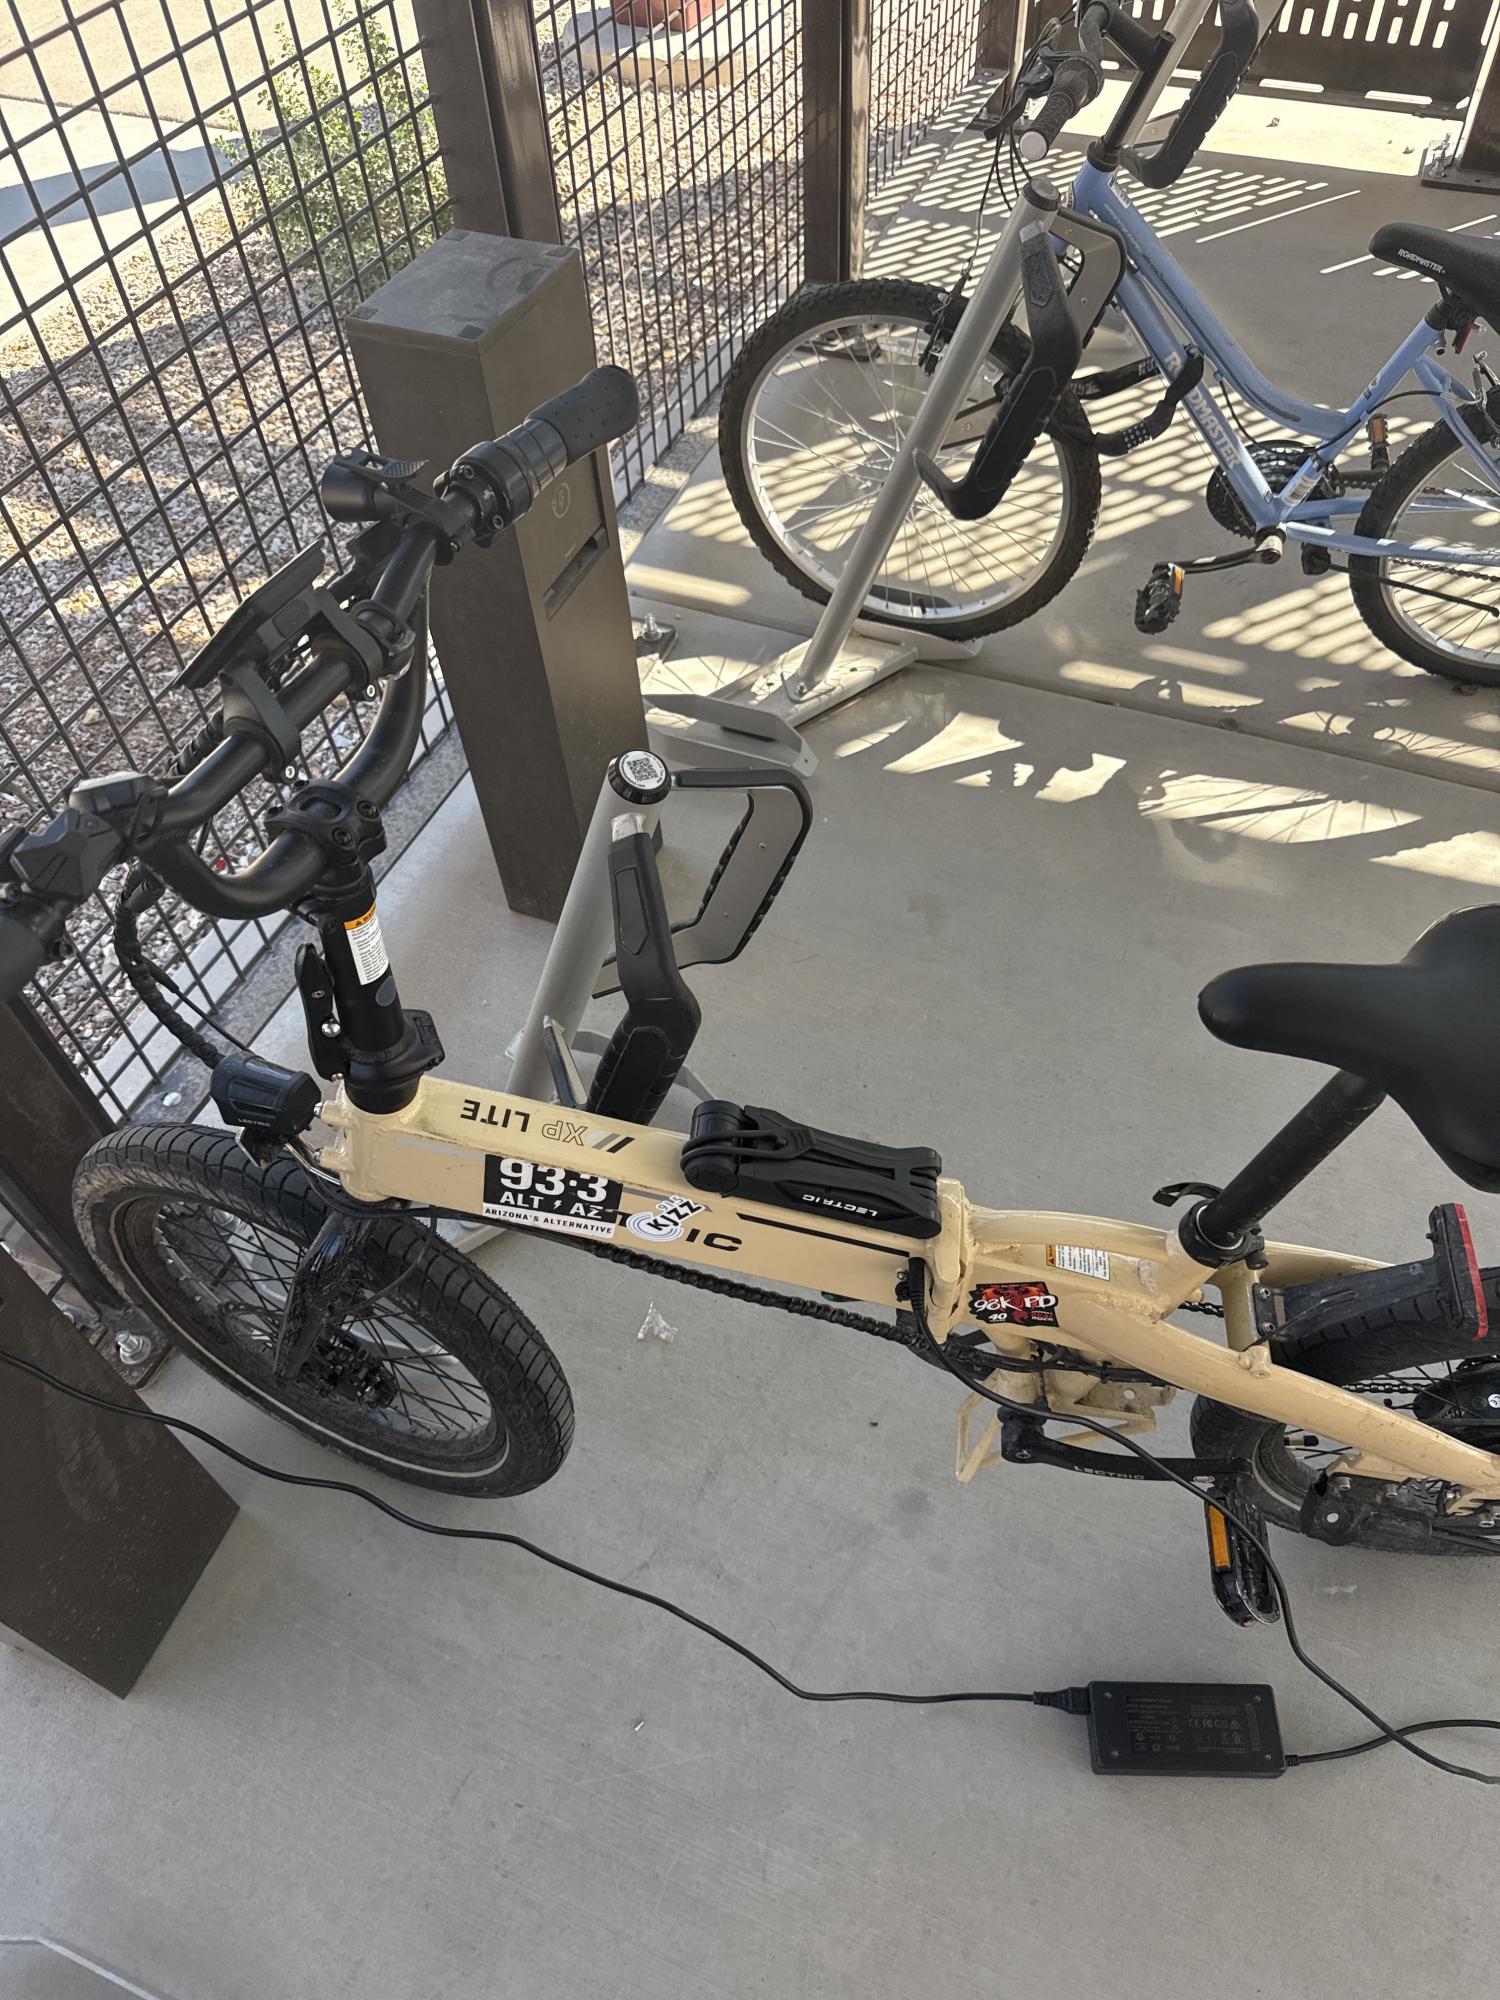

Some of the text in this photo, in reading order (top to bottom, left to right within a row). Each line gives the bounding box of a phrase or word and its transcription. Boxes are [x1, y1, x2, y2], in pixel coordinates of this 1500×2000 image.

[1397, 248, 1444, 274] ROADMASTER
[1164, 352, 1243, 470] RDMASTER
[460, 1099, 589, 1146] XP LITE
[500, 1191, 604, 1219] ALT AZ
[646, 1200, 702, 1232] KJZZ
[802, 1194, 878, 1217] LECTRIC
[485, 1208, 613, 1234] ARIZONA'S ALTERNATIVE
